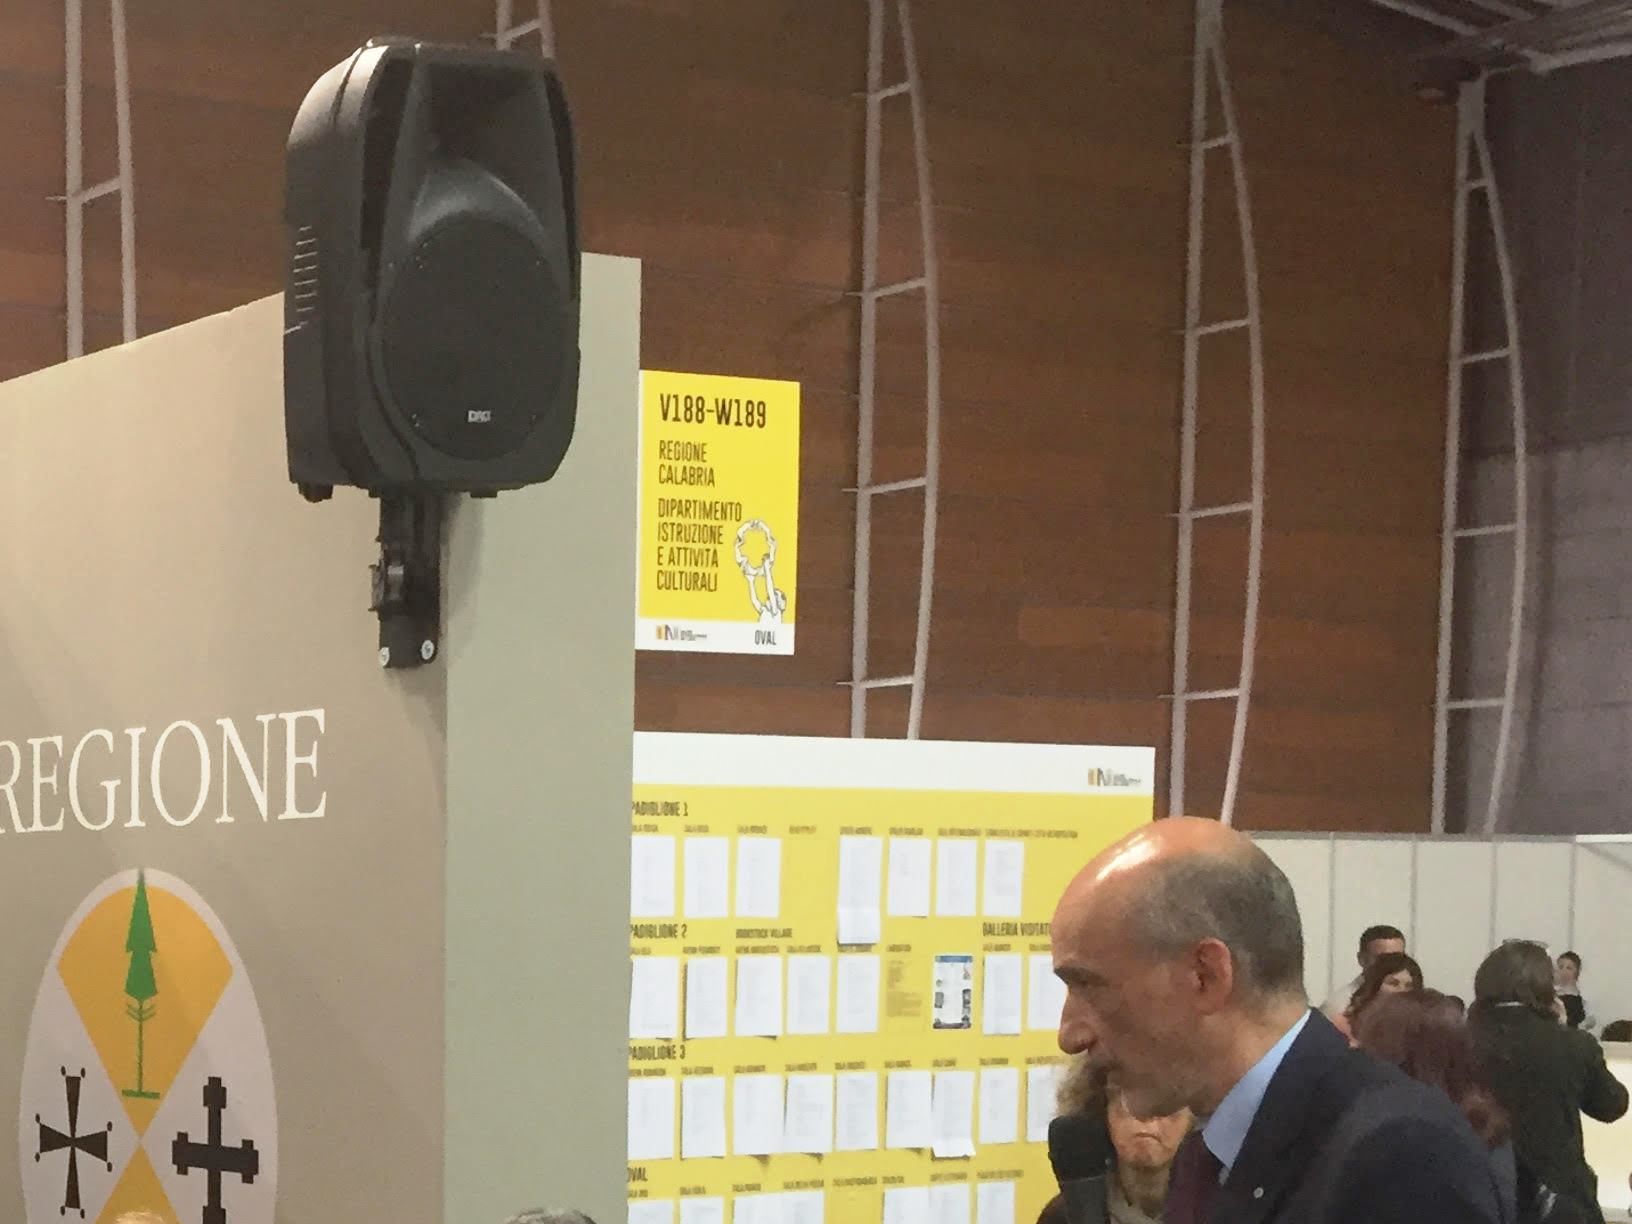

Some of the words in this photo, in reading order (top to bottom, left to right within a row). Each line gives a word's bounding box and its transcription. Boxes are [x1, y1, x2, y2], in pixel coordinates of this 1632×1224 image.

[660, 393, 766, 428] V188-W189
[659, 440, 707, 462] REGIONE
[659, 464, 715, 487] CALABRIA
[658, 498, 742, 522] DIPARTIMENTO
[657, 522, 724, 545] ISTRUZIONE
[657, 547, 663, 566] E
[657, 570, 718, 592] CULTURALI
[754, 630, 776, 646] OVAL
[683, 802, 688, 816] 1
[681, 924, 687, 938] 2
[680, 1045, 686, 1059] 3
